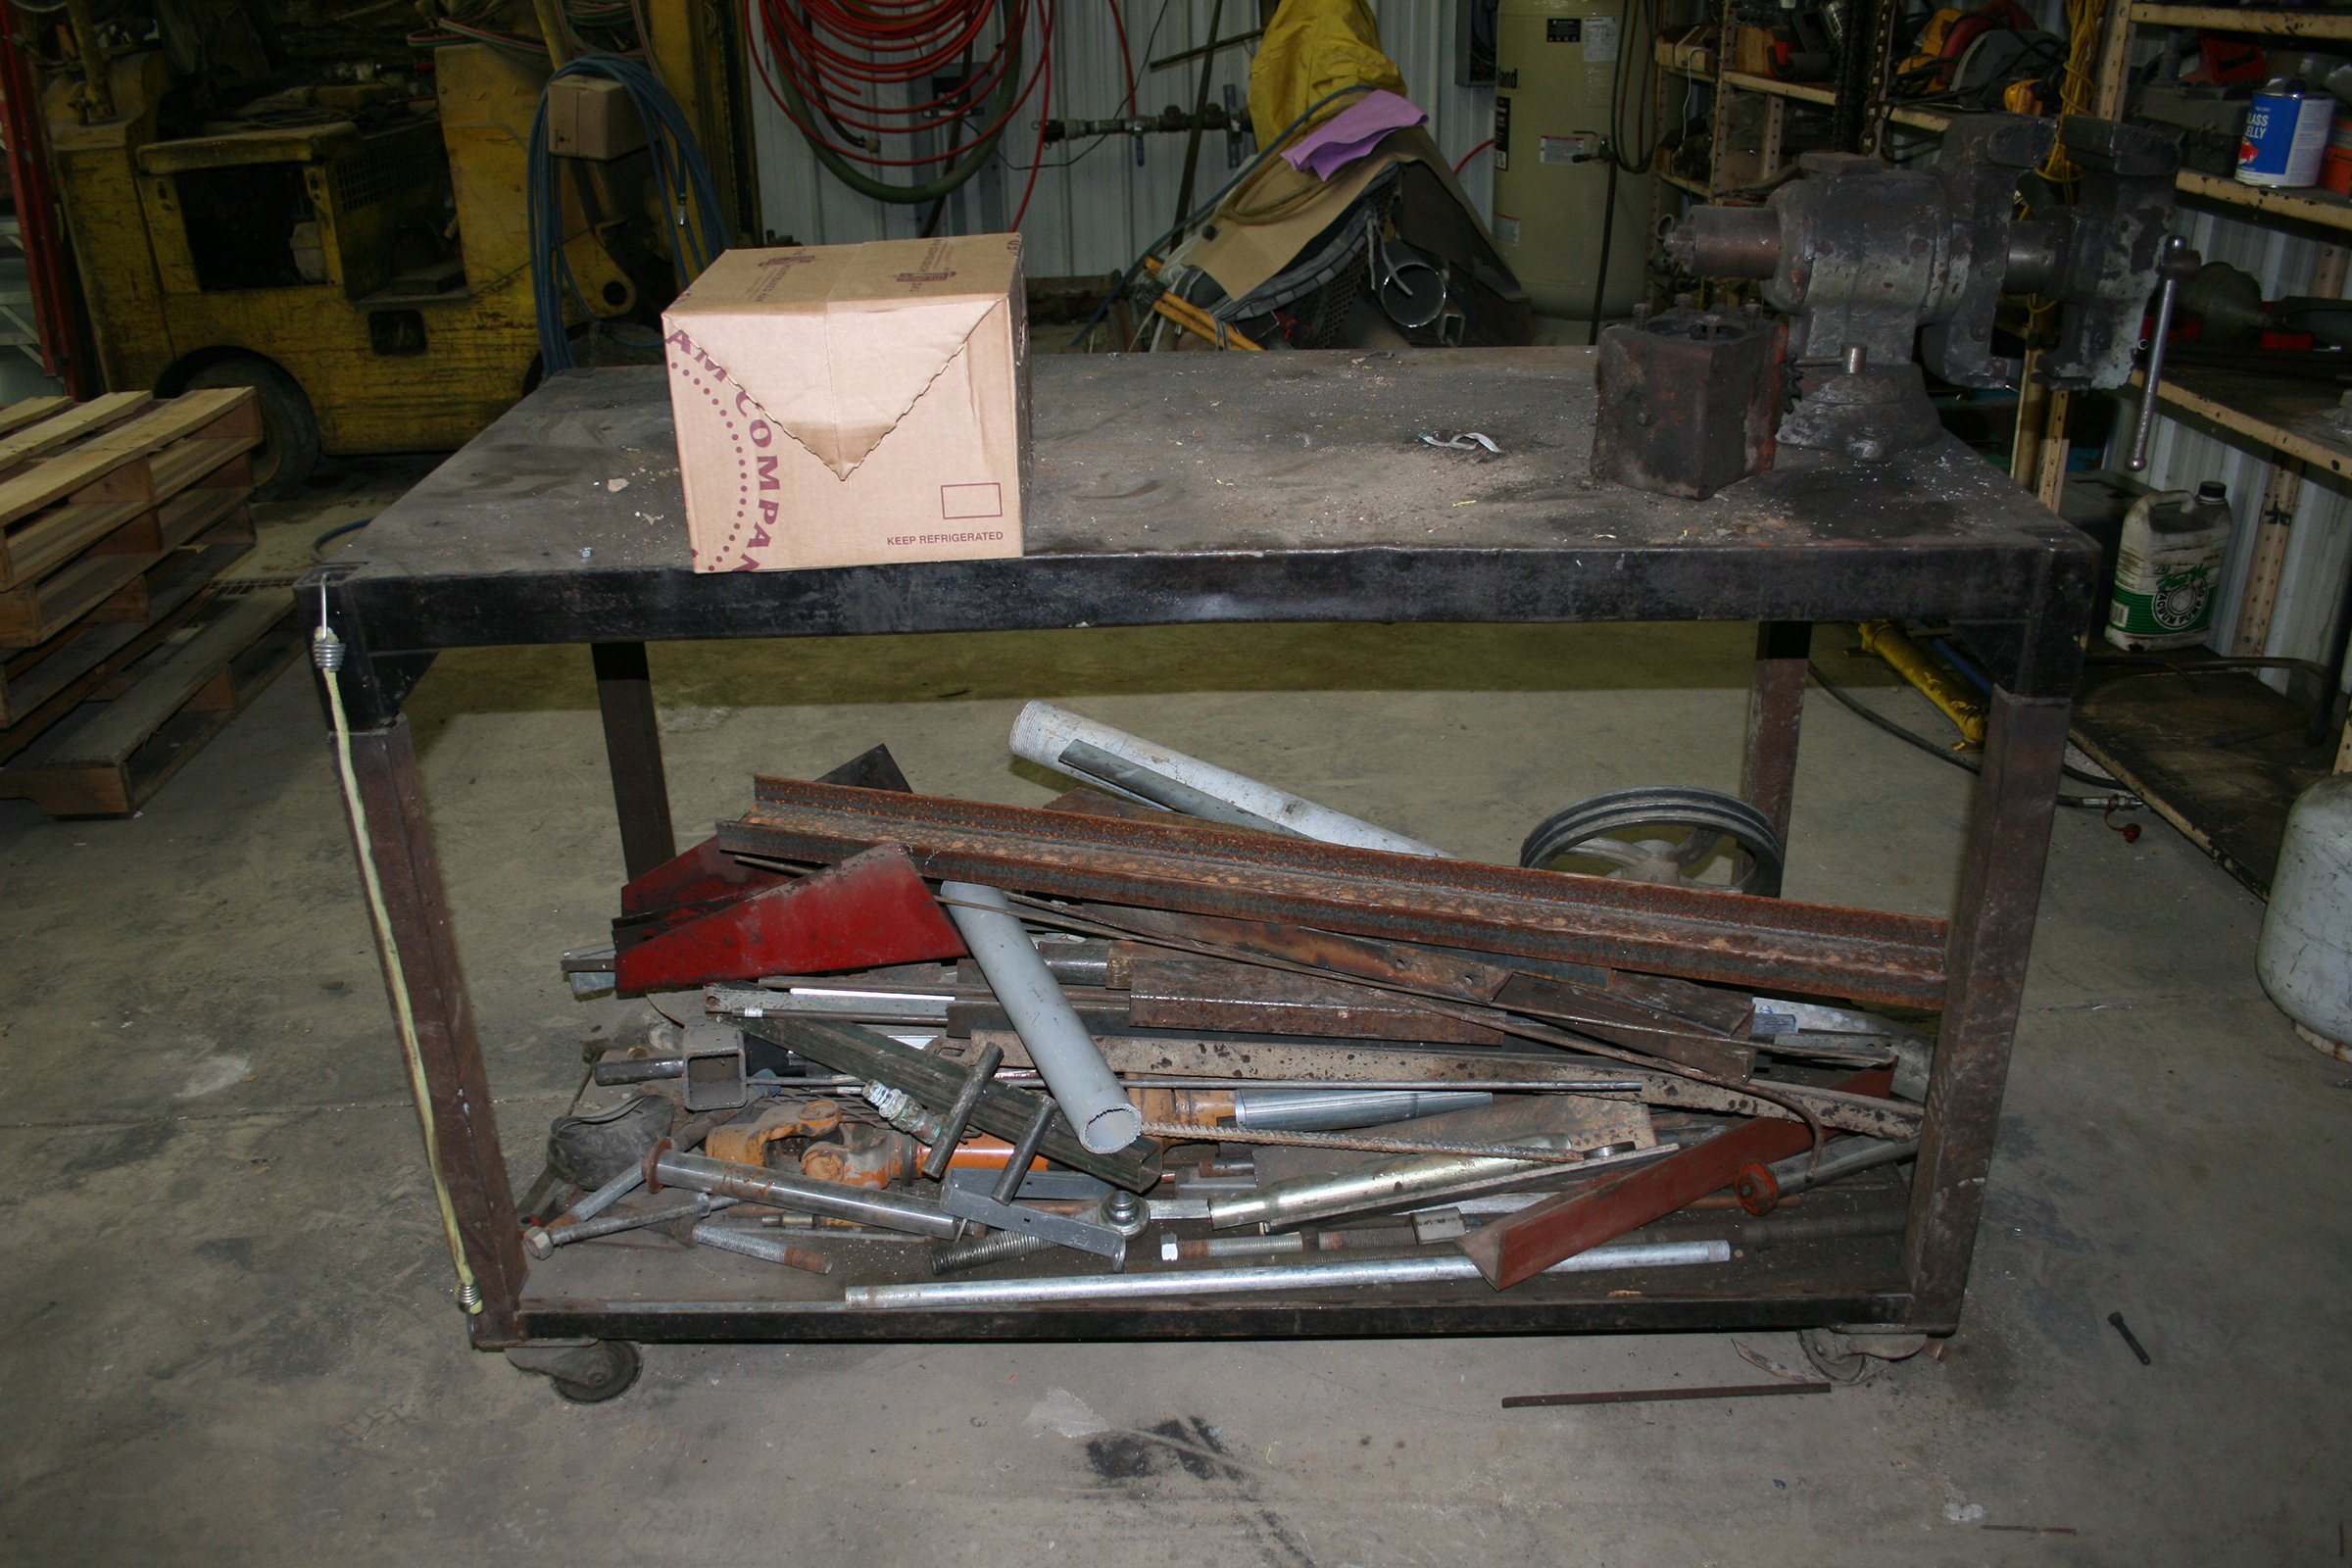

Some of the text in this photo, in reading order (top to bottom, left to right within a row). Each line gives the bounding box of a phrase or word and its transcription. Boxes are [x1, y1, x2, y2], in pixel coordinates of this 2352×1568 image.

[887, 531, 1004, 546] KEEP REFRIGERATED
[2157, 590, 2177, 624] VACUUM
